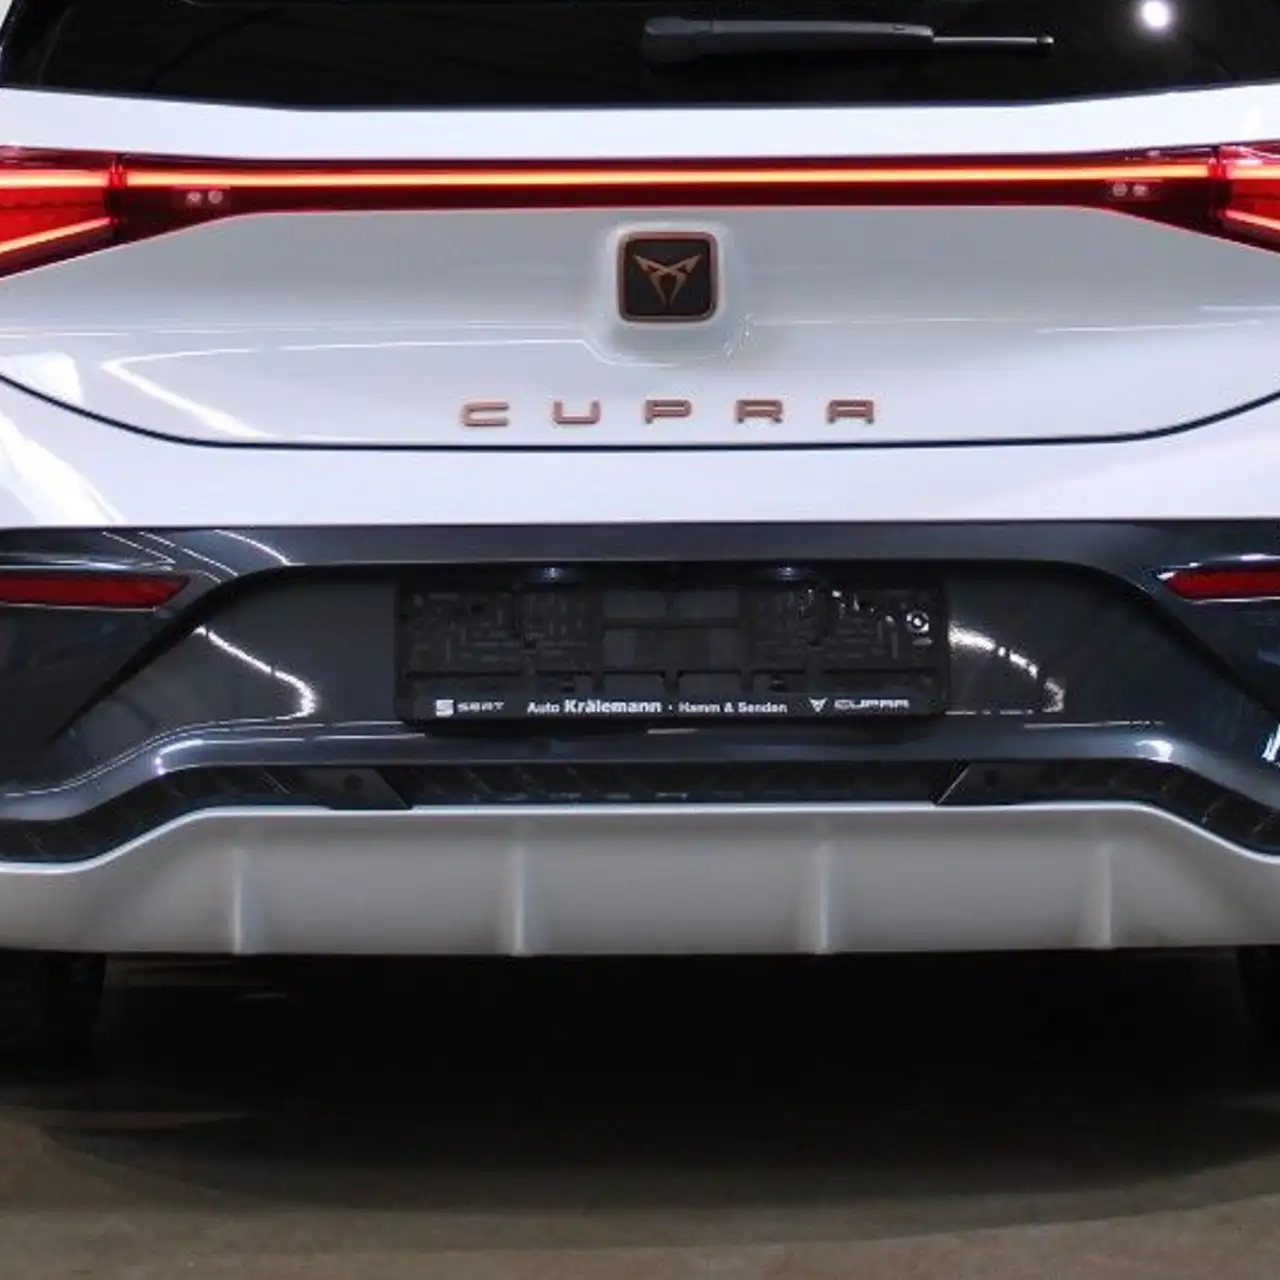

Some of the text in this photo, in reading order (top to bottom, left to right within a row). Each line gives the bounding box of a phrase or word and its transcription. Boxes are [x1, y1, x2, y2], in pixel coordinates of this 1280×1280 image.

[461, 399, 876, 429] CUPRA
[457, 701, 505, 713] SEAT
[527, 701, 561, 715] Auto
[563, 698, 663, 715] Krälemann
[678, 701, 720, 715] Hamm
[724, 701, 736, 715] &
[834, 699, 910, 712] CUPRA
